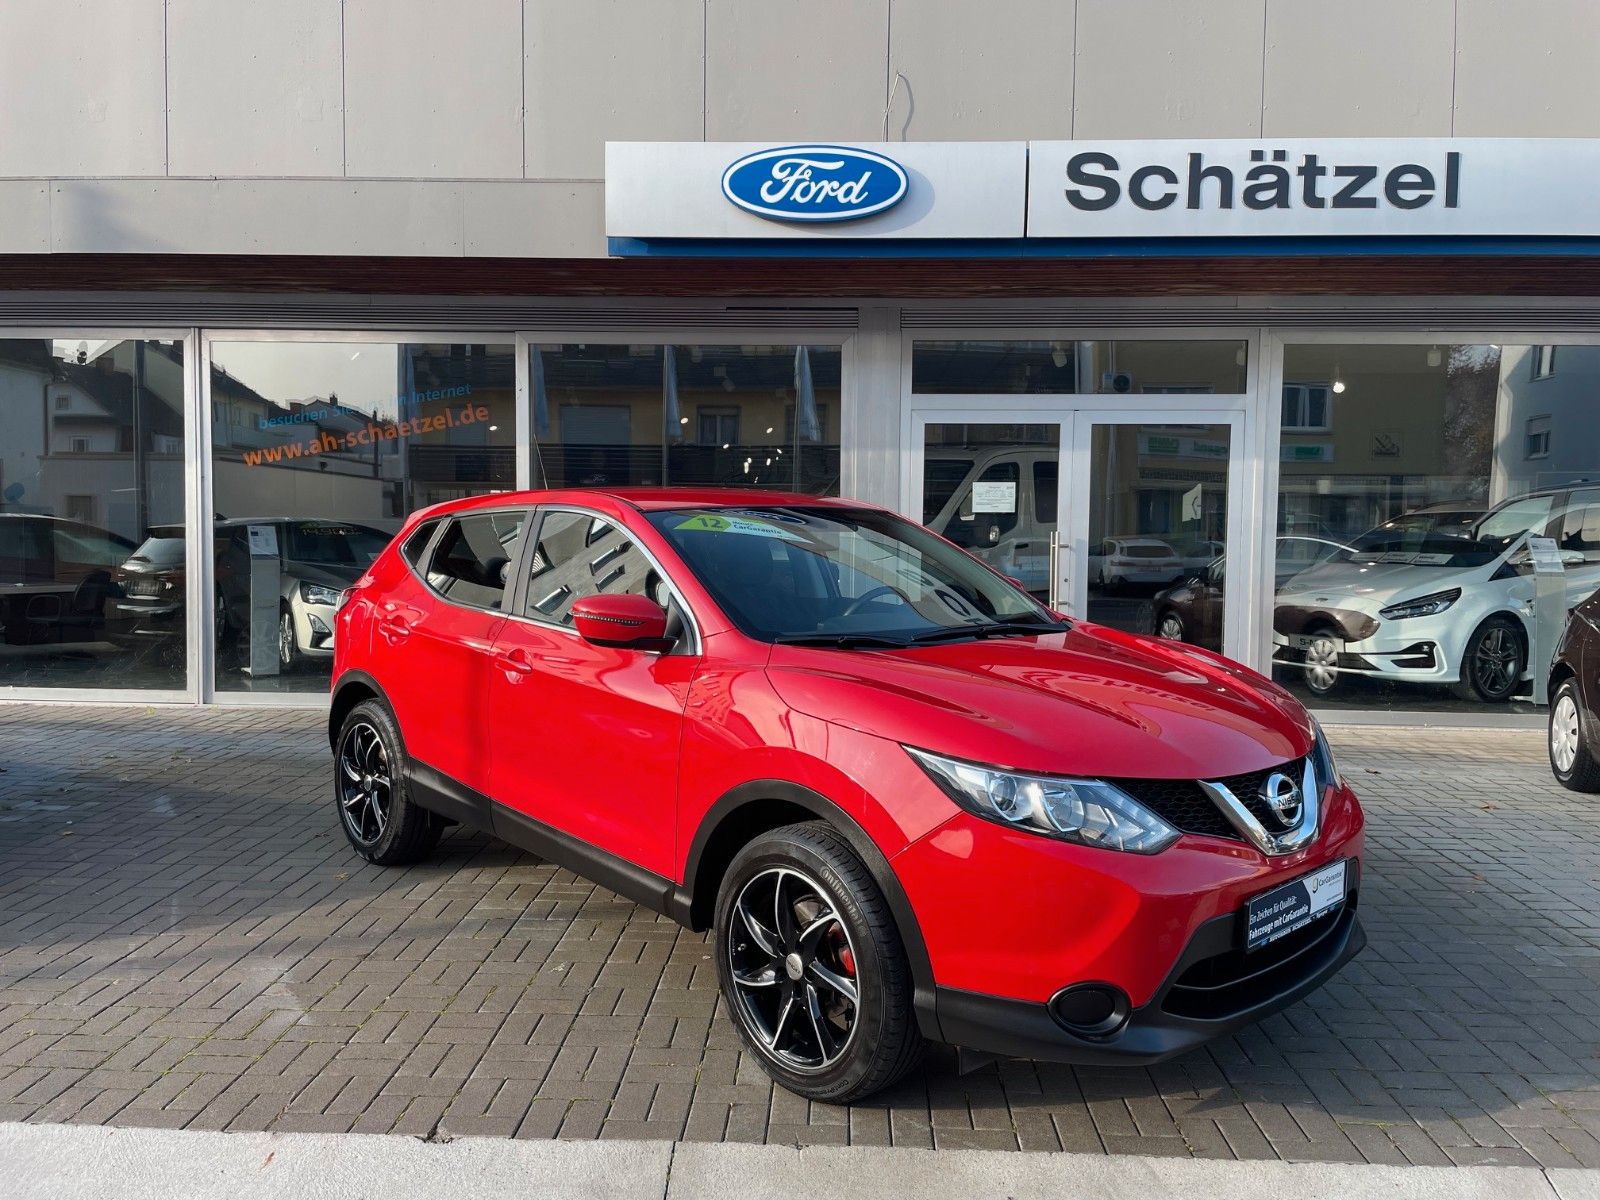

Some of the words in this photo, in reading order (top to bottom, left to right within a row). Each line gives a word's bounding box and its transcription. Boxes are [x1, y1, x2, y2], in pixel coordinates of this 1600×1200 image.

[760, 158, 872, 204] Ford
[1064, 149, 1461, 211] Schätzel
[258, 406, 328, 430] besuchen
[412, 383, 471, 404] Internet
[243, 401, 489, 467] www.ah-schaetzel.de
[697, 516, 724, 529] 12
[819, 865, 863, 925] Continental
[1249, 914, 1257, 925] Ein
[1256, 907, 1273, 922] Zeichen
[1249, 920, 1273, 940] Fahrzeuge
[1273, 916, 1283, 928] mit
[1282, 903, 1309, 924] CarGarantie
